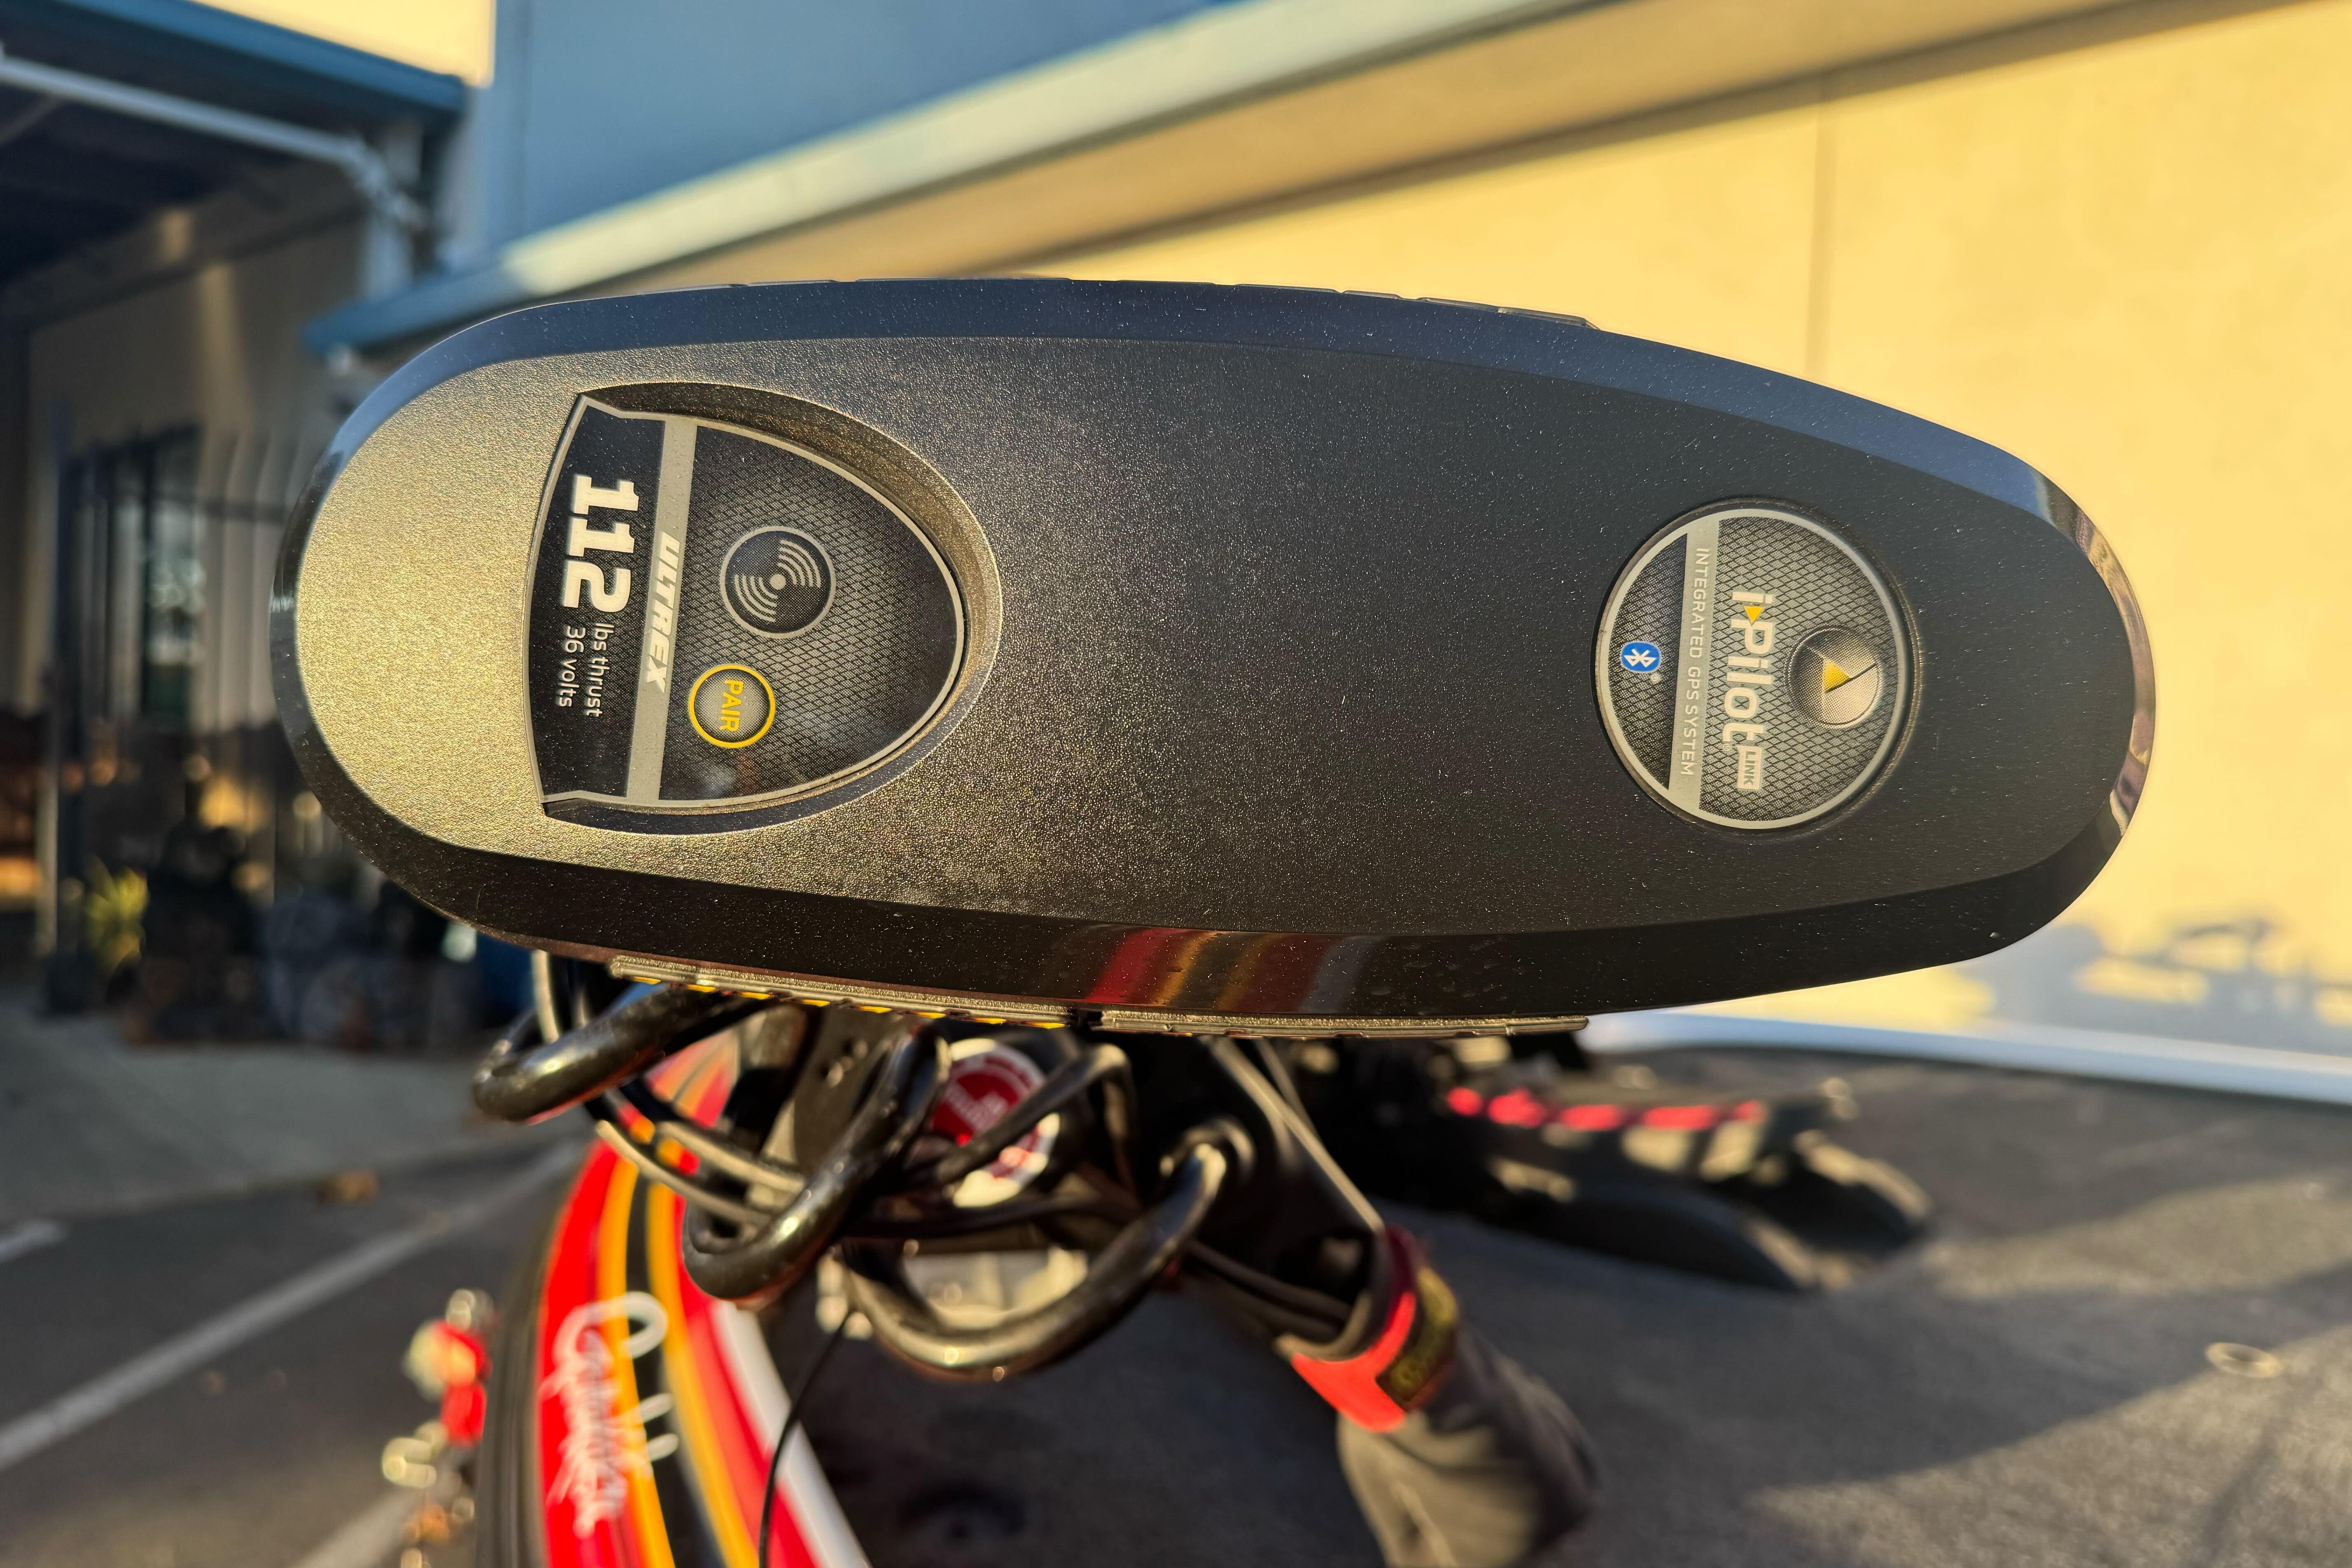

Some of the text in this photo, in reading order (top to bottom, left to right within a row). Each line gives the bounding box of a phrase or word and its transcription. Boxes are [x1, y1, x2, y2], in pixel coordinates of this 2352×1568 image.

[563, 474, 639, 613] 112
[647, 532, 680, 693] ULTREX
[559, 625, 586, 707] 36 volts
[588, 623, 614, 717] lbs thrust
[719, 679, 742, 732] PAIR
[1681, 548, 1710, 775] INTEGRATED GPS SYSTEM
[1743, 751, 1756, 785] LINK
